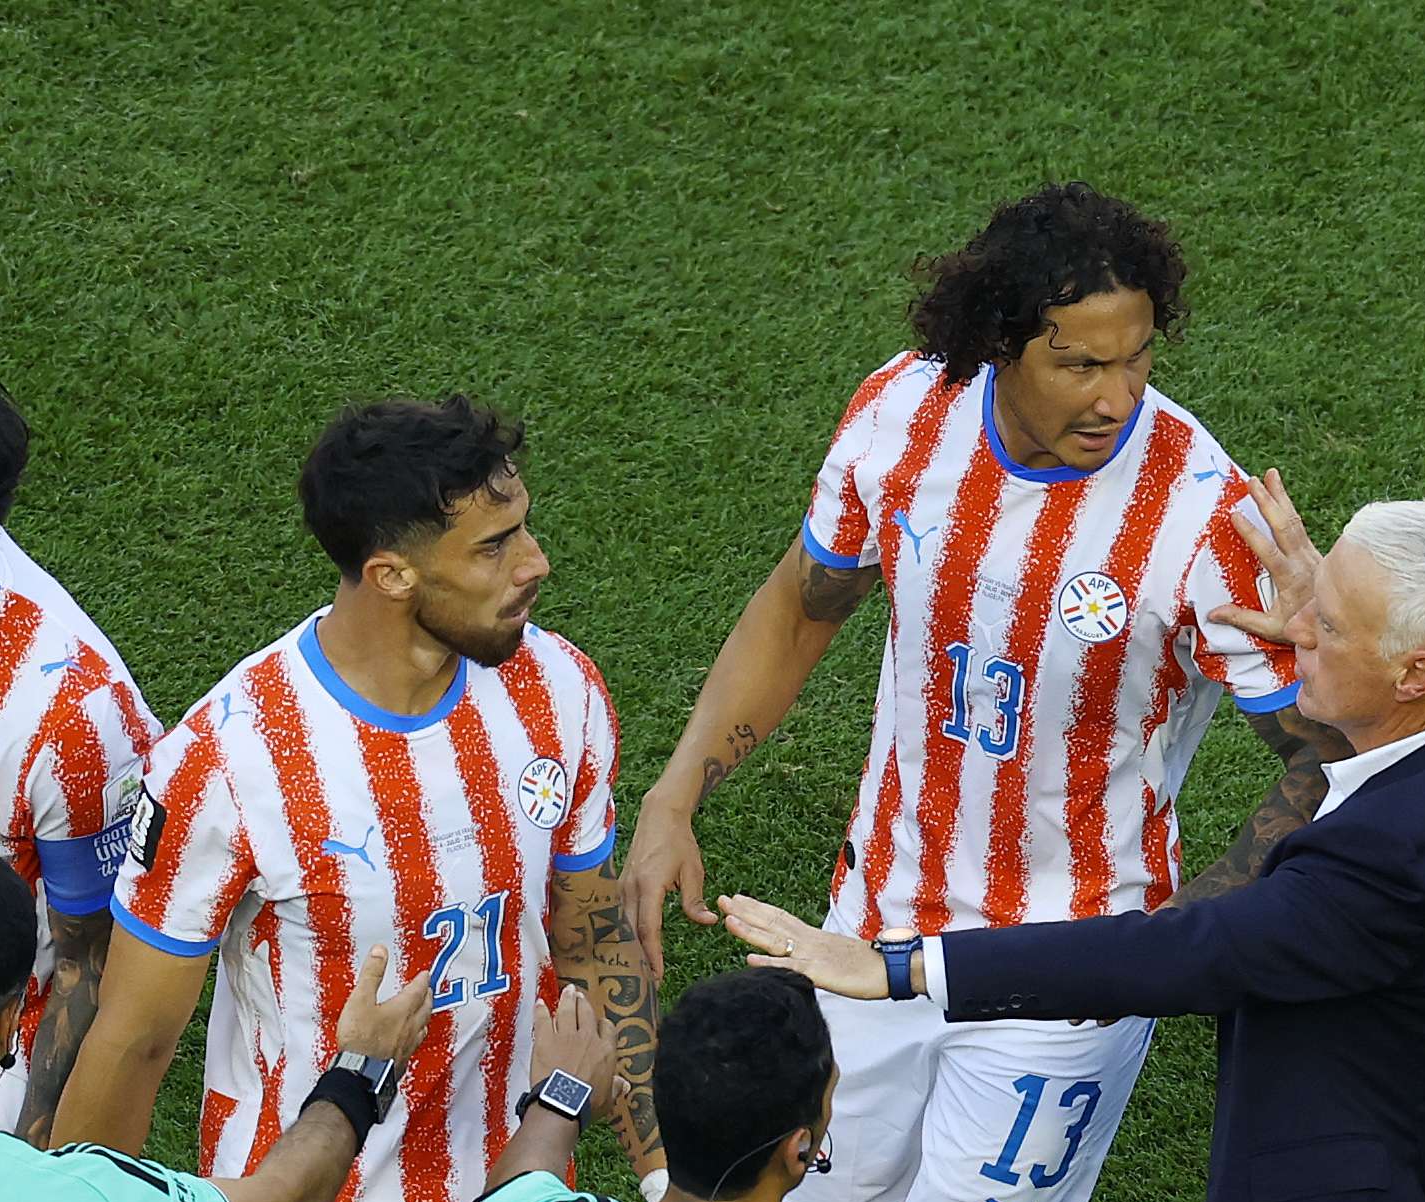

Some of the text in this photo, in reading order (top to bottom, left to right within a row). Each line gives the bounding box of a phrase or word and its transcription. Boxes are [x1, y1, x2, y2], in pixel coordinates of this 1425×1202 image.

[1088, 577, 1112, 592] APF
[942, 641, 1025, 761] 13
[532, 762, 548, 777] APF
[424, 890, 510, 1014] 21
[979, 1074, 1102, 1189] 13
